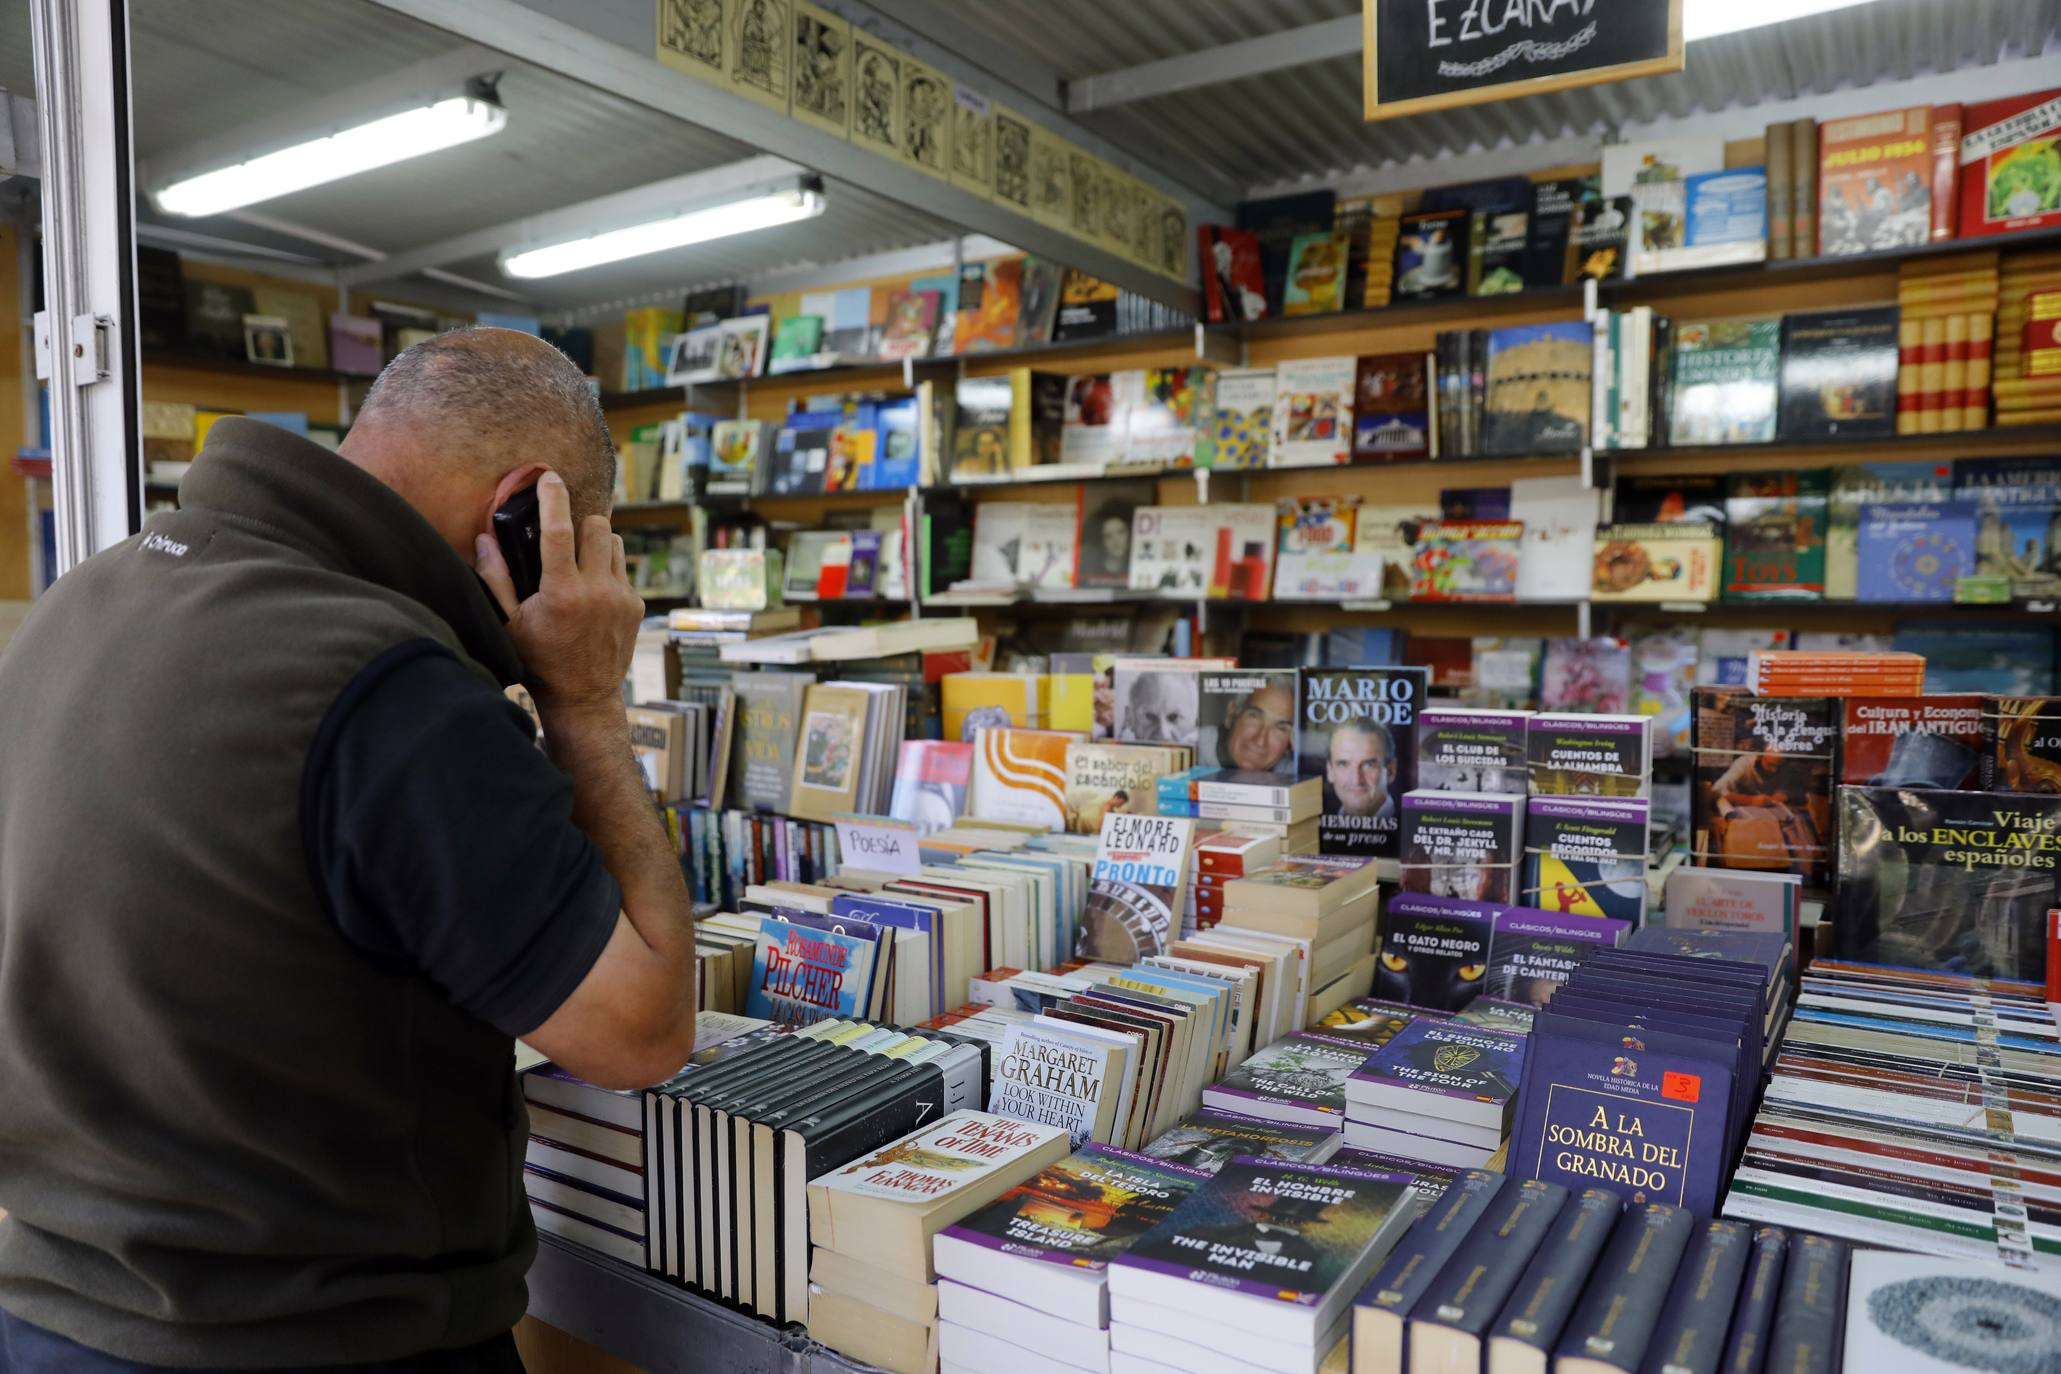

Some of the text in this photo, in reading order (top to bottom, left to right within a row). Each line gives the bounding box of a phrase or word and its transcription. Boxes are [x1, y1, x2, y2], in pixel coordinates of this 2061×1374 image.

[1307, 677, 1413, 702] MARIO
[1306, 700, 1413, 726] CONDE
[1442, 744, 1500, 755] EL CLUB DE
[1551, 750, 1620, 761] CUENTOS DE
[1435, 754, 1508, 766] LOS SUICIDAS
[1562, 761, 1624, 773] ALHAMBRA
[1113, 816, 1175, 837] ELMORE
[1318, 814, 1399, 831] MEMORIAS
[1417, 826, 1494, 839] EL EXTRAÑO CASO
[1992, 811, 2056, 834] Viaje
[1106, 831, 1180, 854] LEONARD
[1413, 834, 1499, 849] DEL DR. JEKYLL
[1558, 833, 1612, 847] CUENTOS
[1881, 826, 2061, 852] a los ENCLAVES
[1423, 845, 1432, 855] Y
[1456, 847, 1487, 858] HYDE
[1943, 848, 2056, 872] españoles
[1094, 859, 1178, 887] PRONTO
[1509, 922, 1602, 939] CLÁSICOS/BILINGÜES
[784, 928, 849, 969] ROSAMUNDE
[1392, 932, 1480, 952] EL GATO NEGRO
[1413, 945, 1435, 955] OTROS
[1436, 948, 1463, 958] RELATOS
[1512, 954, 1527, 964] EL
[761, 945, 844, 1011] PILCHER
[1503, 965, 1518, 976] DE
[1283, 1045, 1301, 1053] DE
[1295, 1043, 1312, 1051] LA
[1424, 1034, 1515, 1053] LOS CUATRO
[1446, 1033, 1495, 1045] SIGNO
[1013, 1038, 1098, 1076] MARGARET
[1000, 1055, 1100, 1103] GRAHAM
[1391, 1064, 1420, 1074] THE
[1423, 1071, 1462, 1081] SIGN
[1398, 1071, 1472, 1089] THE FOUR
[1587, 1072, 1659, 1092] NOVELA HISTÓRICA DE LA
[1250, 1077, 1335, 1097] THE CALL OF
[1255, 1083, 1318, 1099] THE WILD
[1603, 1082, 1640, 1095] EDAD MEDIA
[1003, 1082, 1086, 1118] LOOK WITHIN
[991, 1119, 1024, 1131] THE
[1001, 1096, 1083, 1134] YOUR HEART
[1589, 1105, 1645, 1137] A LA
[955, 1120, 1039, 1147] TENANTS
[934, 1136, 1009, 1159] OF TIME
[1548, 1124, 1682, 1169] SOMBRA DEL
[895, 1169, 958, 1188] THOMAS
[1105, 1169, 1161, 1189] LA ISLA
[1556, 1151, 1666, 1192] GRANADO
[864, 1170, 946, 1194] FLANAGAN
[1079, 1171, 1170, 1199] DEL TESORO
[1251, 1177, 1356, 1199] EL HOMBRE
[1249, 1184, 1345, 1205] INVISIBLE
[1006, 1227, 1073, 1249] ISLAND
[1009, 1217, 1097, 1244] TREASURE
[1171, 1235, 1313, 1273] THE INVISIBLE
[1207, 1254, 1256, 1271] MAN
